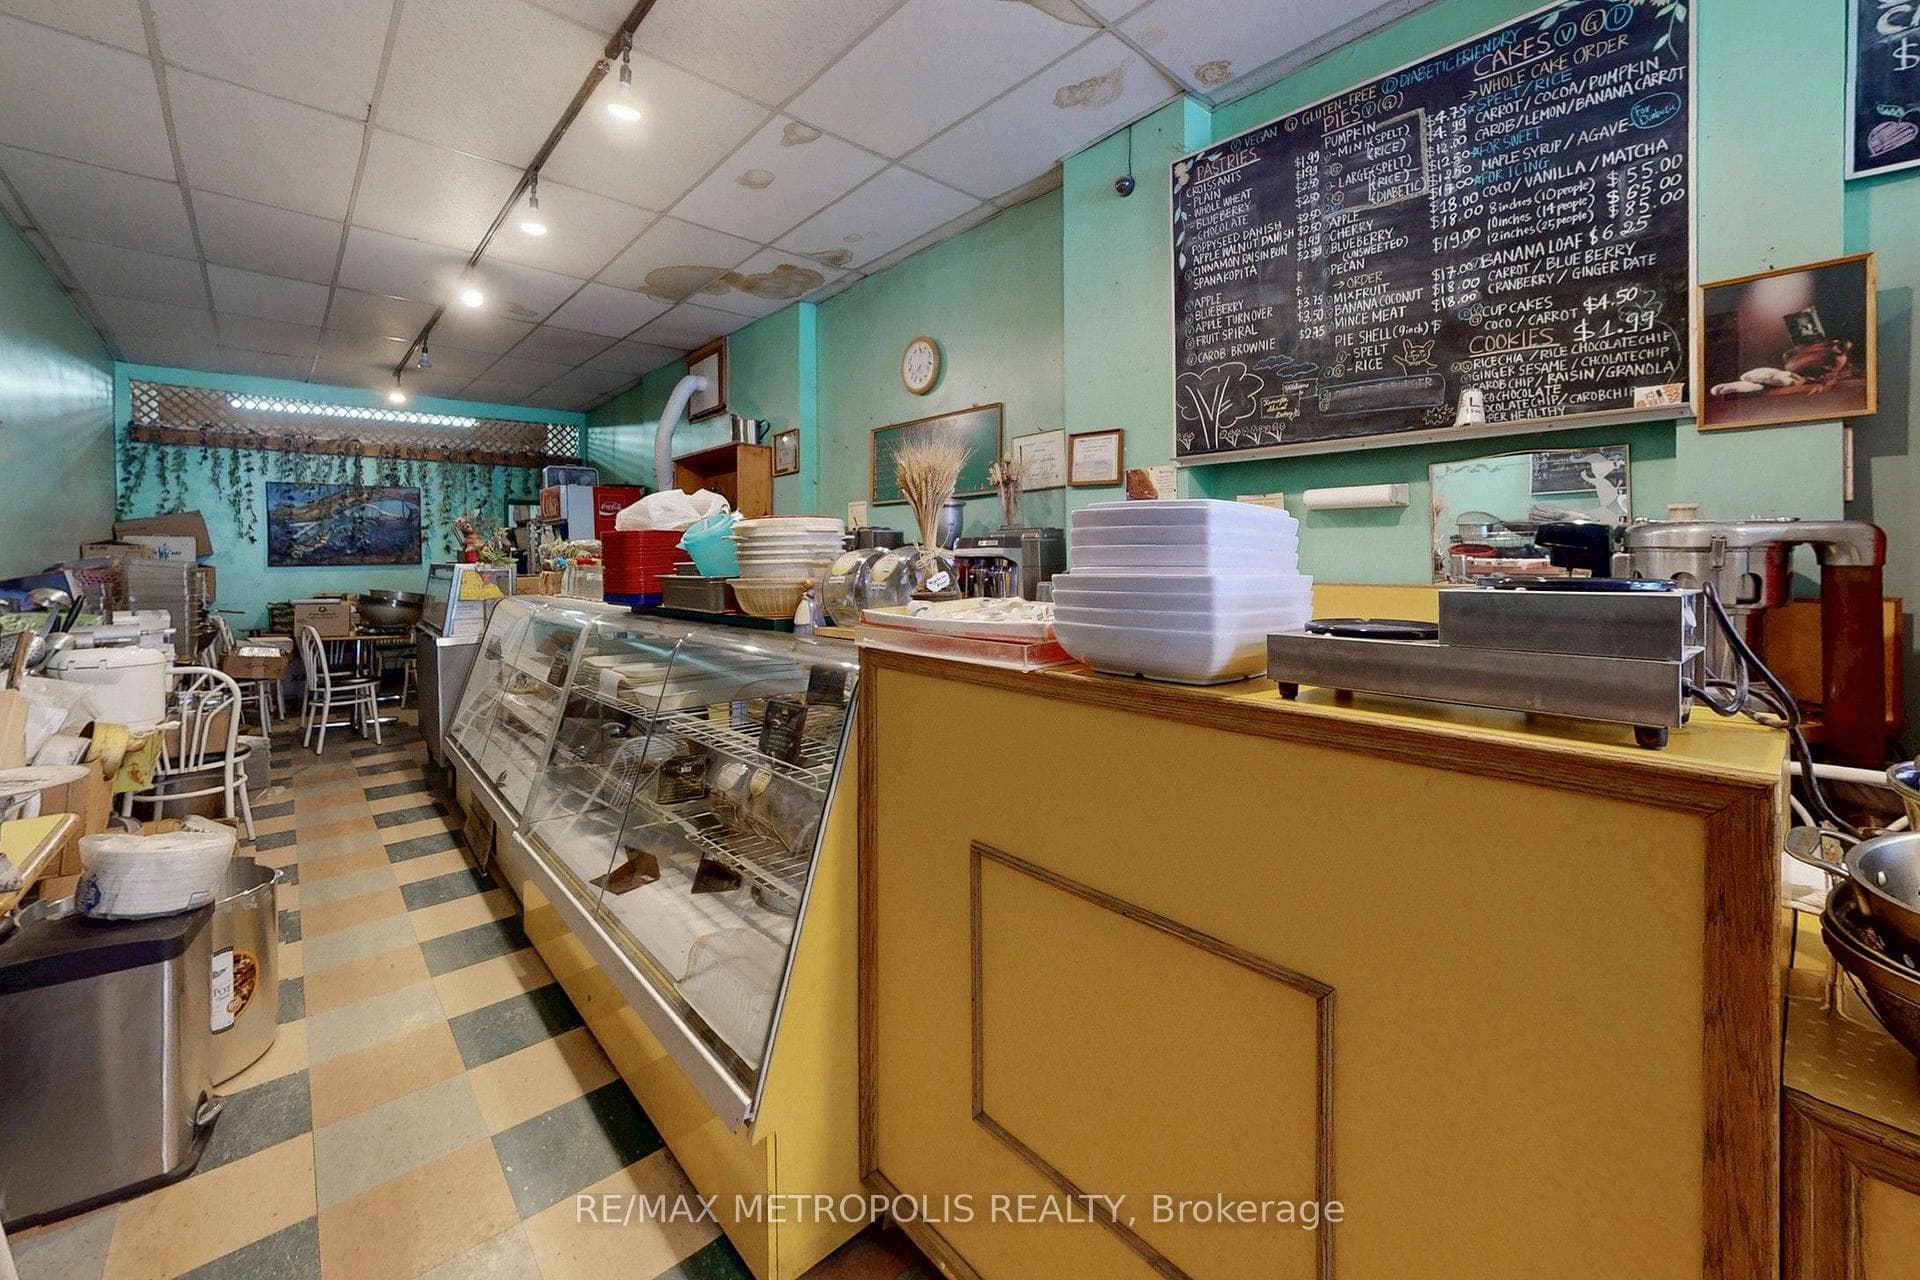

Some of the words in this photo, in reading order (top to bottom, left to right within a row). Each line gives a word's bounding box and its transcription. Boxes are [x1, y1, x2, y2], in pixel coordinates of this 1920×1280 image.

[1474, 32, 1551, 76] CAKES
[1479, 69, 1526, 96] WHOLE
[1531, 52, 1569, 79] CAKE
[1573, 34, 1629, 64] ORDER
[1244, 127, 1278, 147] VEGAN
[1302, 86, 1377, 125] GLUTEN-FREE
[1401, 57, 1454, 87] DIABETIC
[1425, 103, 1467, 128] $4.75
[1324, 104, 1361, 132] PIES
[1324, 121, 1376, 149] PUMPKIN
[1479, 139, 1500, 157] FOR
[1504, 126, 1543, 149] SWEET
[1482, 150, 1520, 171] MAPLE
[1522, 139, 1562, 160] SYRUP
[1577, 118, 1630, 146] AGAVE
[1195, 147, 1258, 180] PASTRIES
[1602, 138, 1669, 167] MATCHA
[1186, 170, 1242, 198] CROISSANTS
[1482, 170, 1504, 185] FOR
[1508, 157, 1550, 178] ICING
[1194, 200, 1221, 218] WHOLE
[1223, 188, 1252, 207] WHEAT
[1329, 212, 1360, 228] APPLE
[1430, 192, 1478, 214] $18.00
[1330, 220, 1374, 242] CHERRY
[1430, 205, 1483, 230] $18.00
[1192, 232, 1240, 255] POPPYSEED
[1243, 221, 1282, 240] DANISH
[1194, 249, 1219, 266] APPLE
[1222, 239, 1258, 258] WALNUT
[1261, 228, 1294, 246] DANISH
[1331, 228, 1394, 254] BLUEBERRY
[1432, 227, 1481, 252] $19.00
[1482, 242, 1545, 269] BANANA
[1548, 232, 1583, 254] LOAF
[1193, 256, 1240, 277] CINNAMON
[1270, 244, 1288, 257] BUN
[1330, 258, 1365, 276] PECAN
[1432, 262, 1473, 282] $17.00
[1488, 263, 1531, 281] CARROT
[1488, 272, 1555, 294] CRANBERRY
[1572, 261, 1619, 279] GINGER
[1624, 253, 1657, 270] DATE
[1194, 265, 1257, 290] SPANAKOPITA
[1347, 271, 1383, 288] ORDER
[1194, 293, 1222, 309] APPLE
[1195, 300, 1243, 321] BLUEBERRY
[1335, 297, 1377, 316] BANANA
[1379, 288, 1423, 307] COCONUT
[1432, 277, 1480, 297] $18.00
[1583, 287, 1638, 314] $4.50
[1195, 318, 1222, 333] APPLE
[1227, 307, 1273, 326] TURNOVER
[1335, 311, 1369, 330] MINCE
[1372, 305, 1407, 323] MEAT
[1432, 293, 1477, 312] $18.00
[1528, 308, 1578, 326] CARROT
[1195, 332, 1219, 347] FRUIT
[1223, 325, 1258, 341] SPIRAL
[1335, 333, 1354, 347] PIE
[1359, 327, 1392, 344] SHELL
[1469, 328, 1554, 354] COOKIES
[1573, 310, 1655, 342] $1.99
[1198, 349, 1226, 363] CAROB
[1231, 338, 1275, 357] BROWNIE
[1353, 343, 1388, 358] SPELT
[1355, 358, 1384, 374] RICE
[1472, 364, 1515, 381] GINGER
[1519, 360, 1567, 376] SESAME
[1493, 384, 1561, 399] CHOCOLATE
[1511, 405, 1566, 421] HEALTHY
